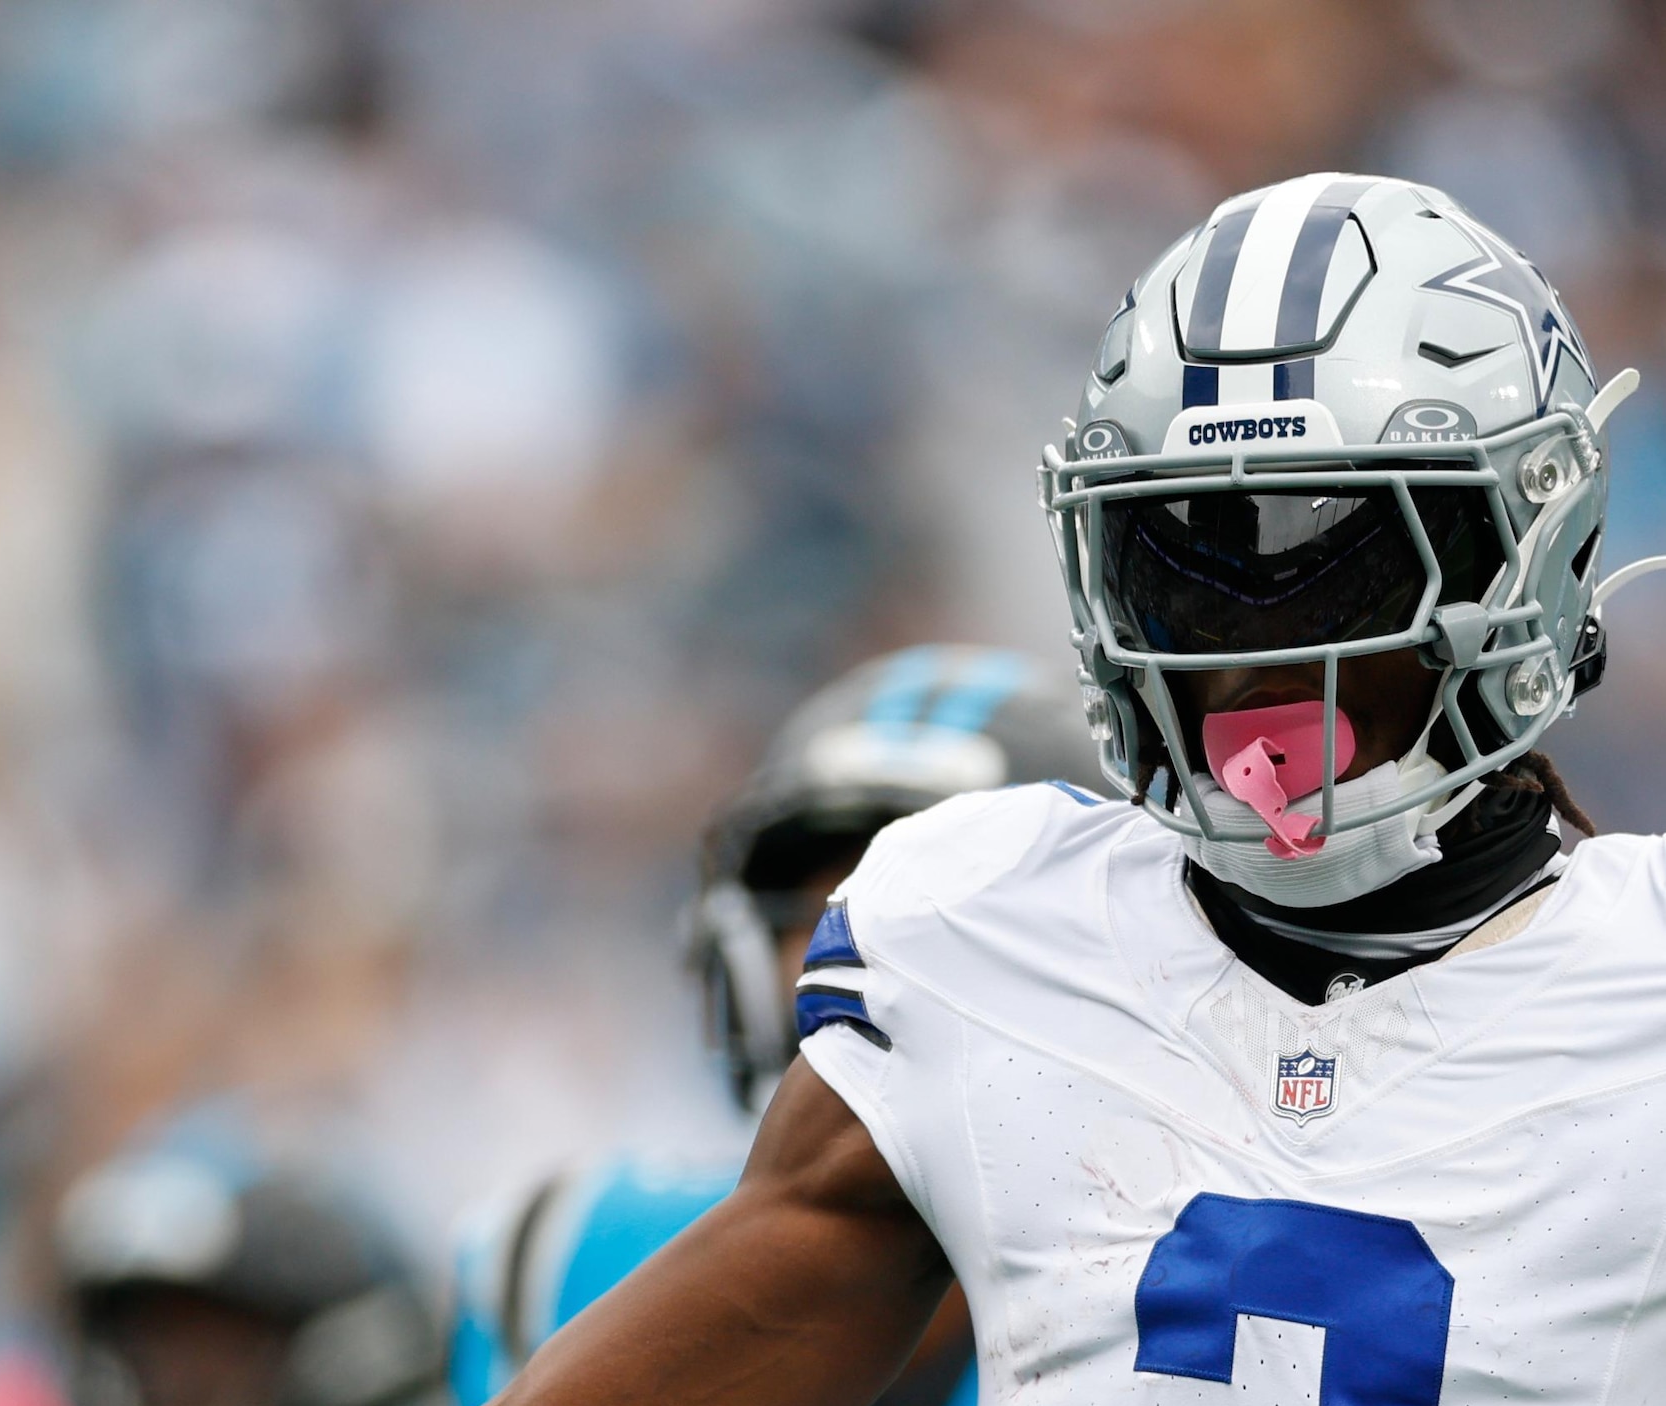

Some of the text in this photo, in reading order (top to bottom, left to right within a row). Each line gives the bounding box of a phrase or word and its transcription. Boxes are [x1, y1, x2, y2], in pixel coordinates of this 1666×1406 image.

[1188, 415, 1307, 446] COWBOYS
[1389, 430, 1471, 443] OAKLEY
[1280, 1079, 1328, 1110] NFL
